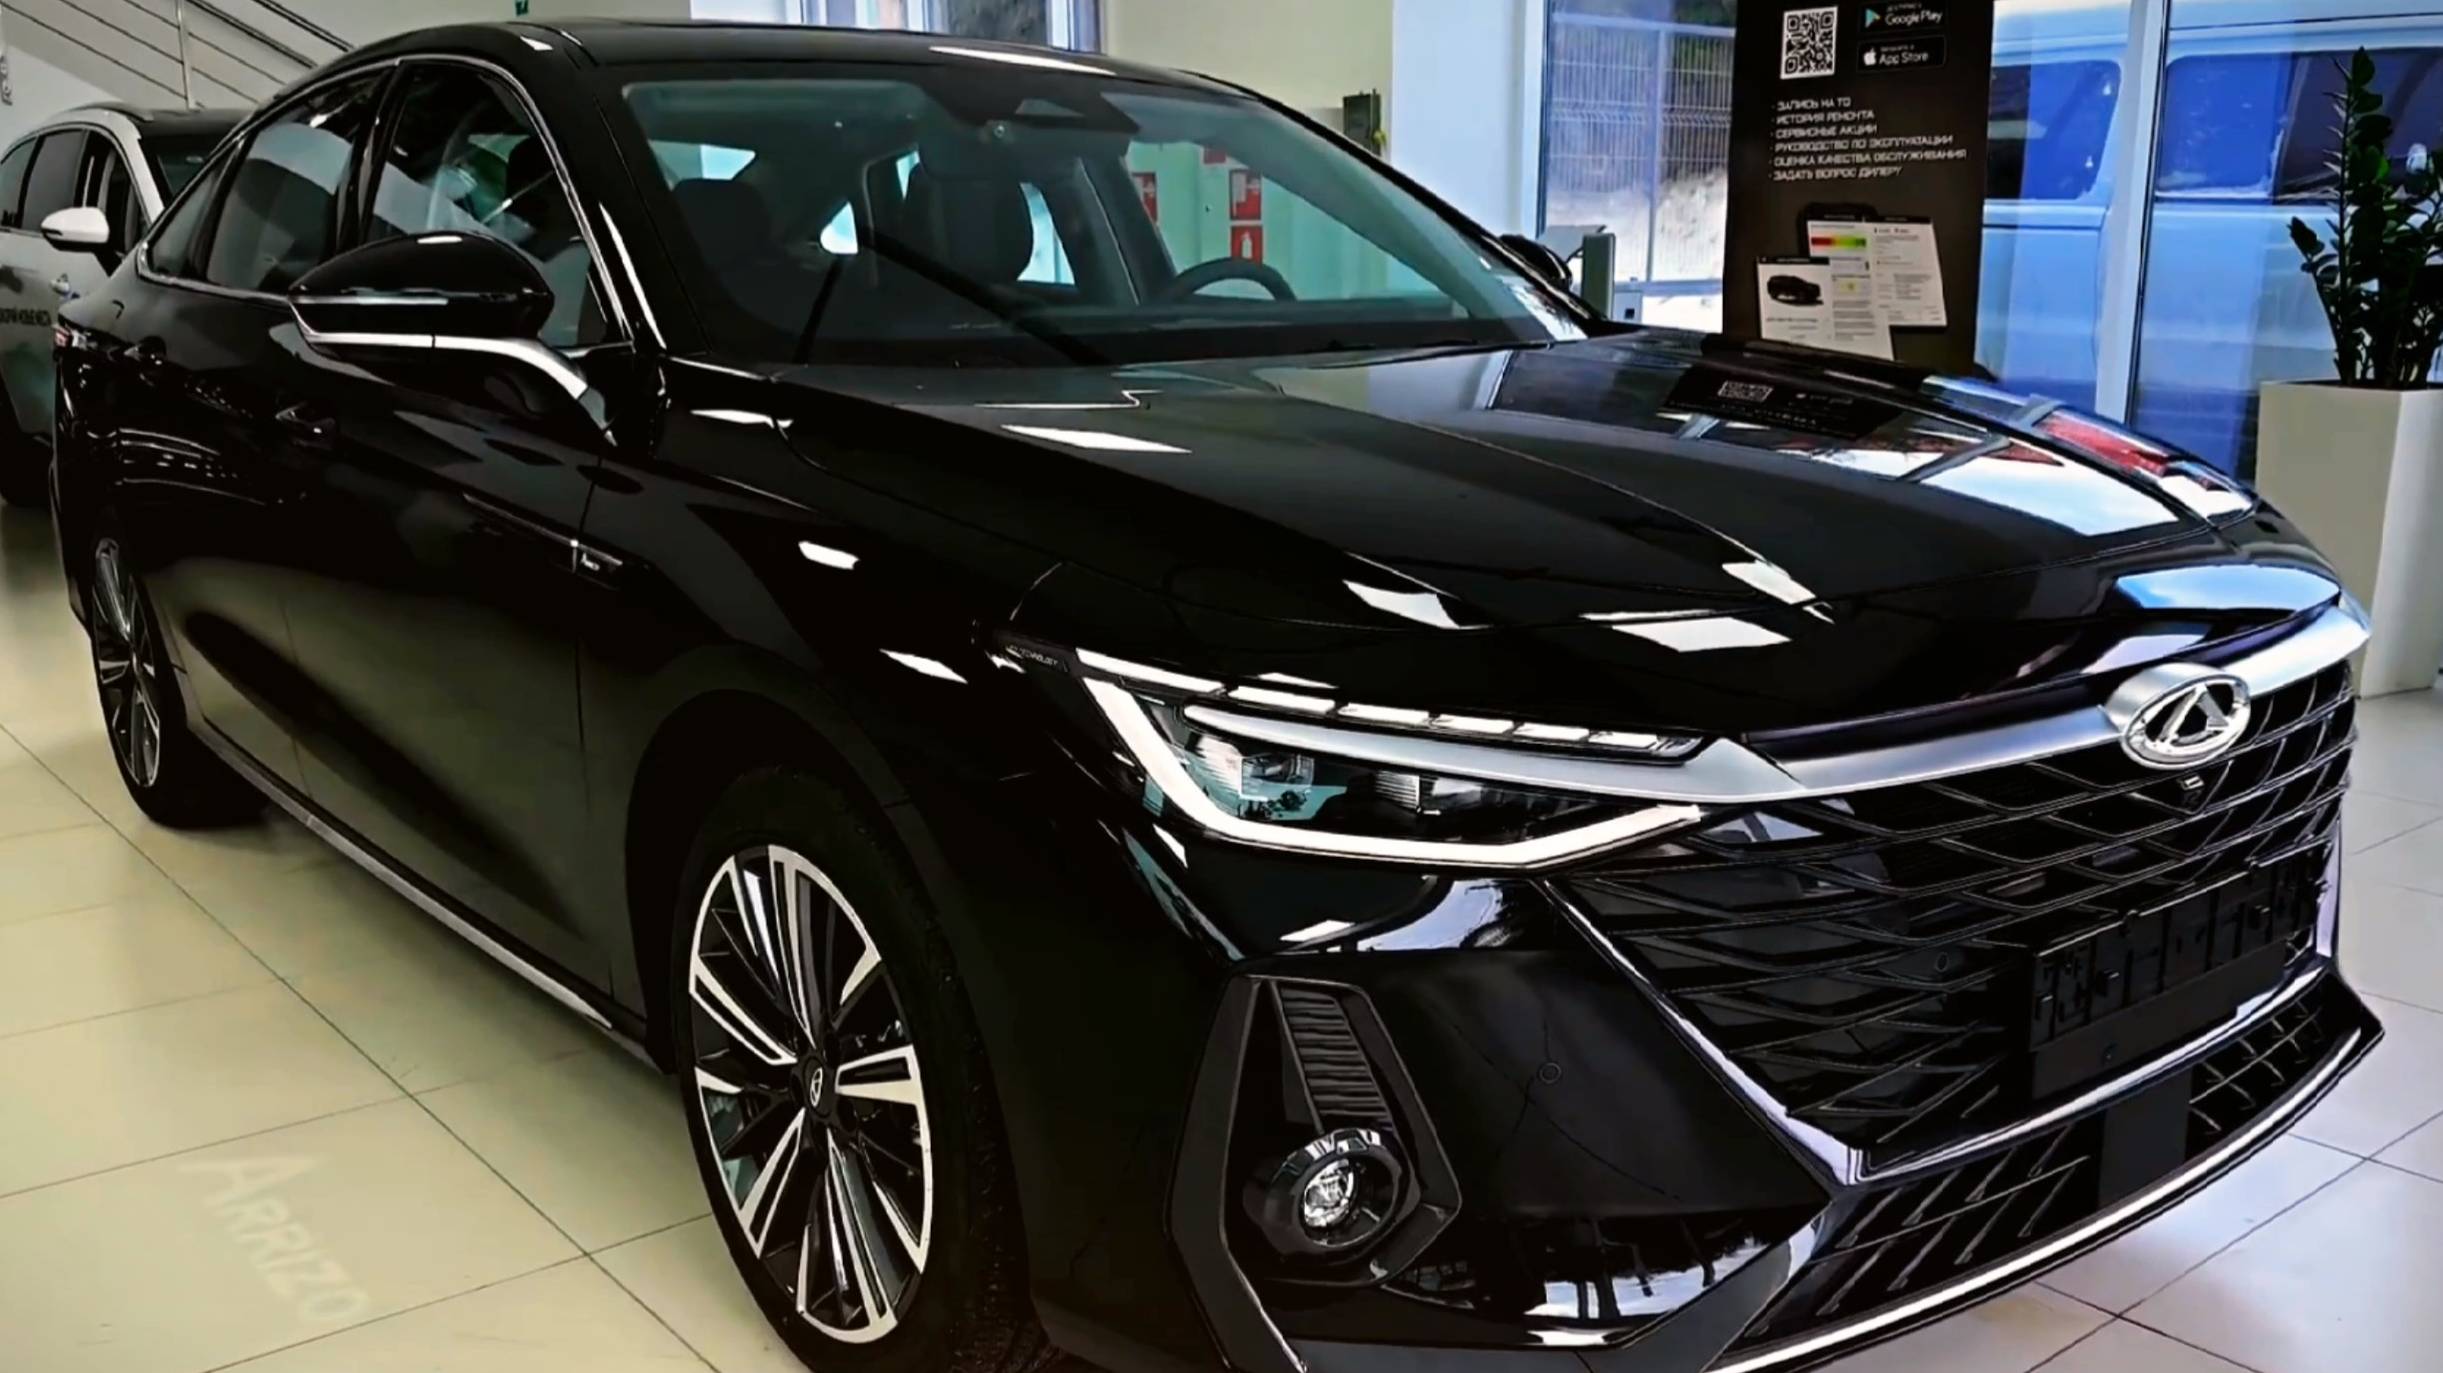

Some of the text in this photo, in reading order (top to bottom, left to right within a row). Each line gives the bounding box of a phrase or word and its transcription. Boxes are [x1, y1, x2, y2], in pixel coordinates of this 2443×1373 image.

[1885, 10, 1943, 26] Google Play
[1879, 51, 1929, 66] App Store
[1777, 97, 1851, 111] ЗАПИСЬ НА ТО
[1776, 110, 1875, 124] ИСТОРИЯ РЕМОНТА
[1775, 123, 1878, 139] СЕРВИСНЫЕ АКЦИИ
[1775, 140, 1850, 153] РУКОВОДСТВО
[1851, 139, 1867, 149] ПО
[1774, 149, 1967, 167] ОЦЕНКА КАЧЕСТВА ОБСЛУЖИВАНИЯ
[1773, 166, 1903, 181] ЗАДАТЬ ВОПРОС ДИЛЕРУ
